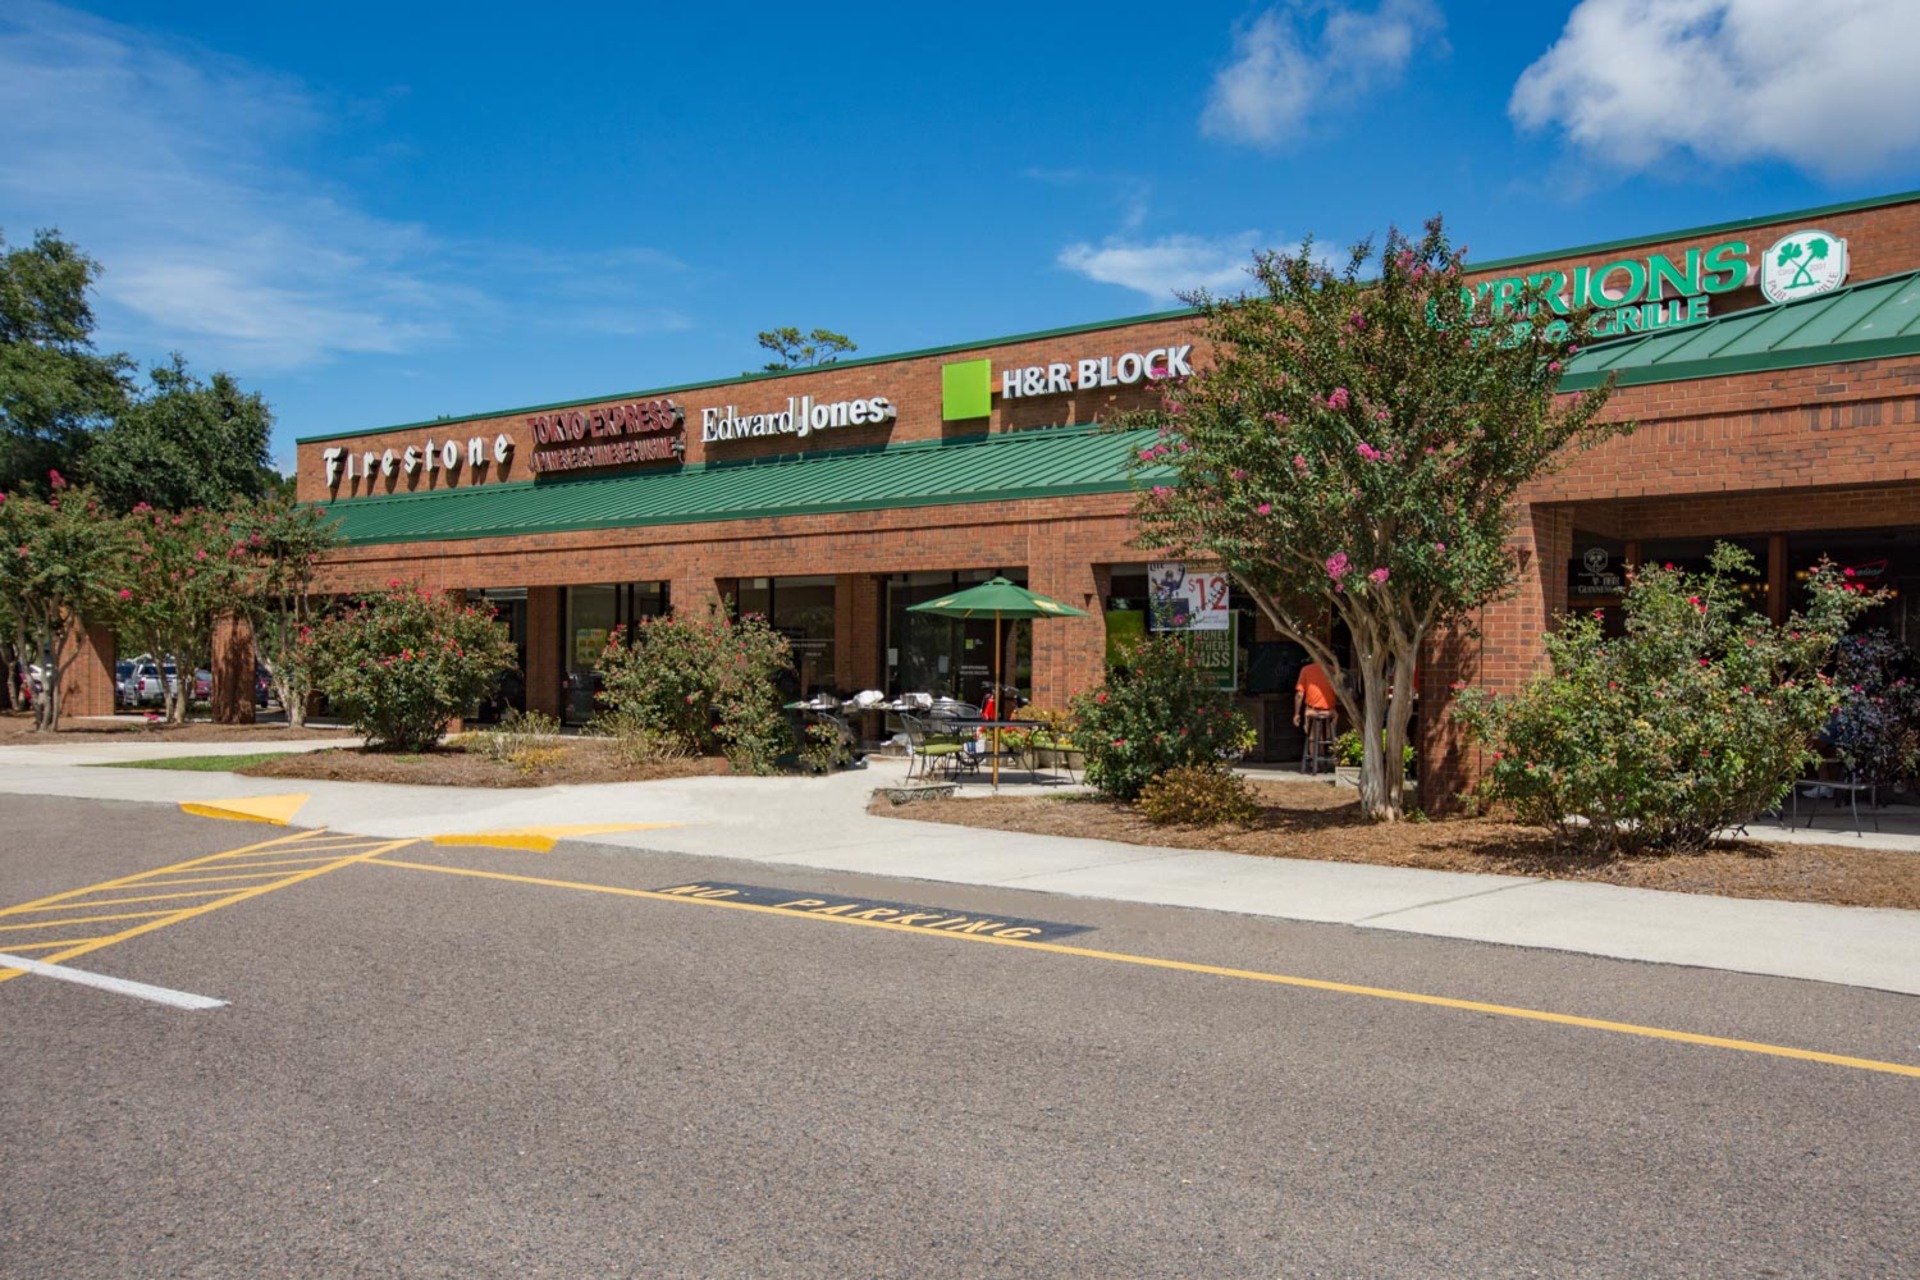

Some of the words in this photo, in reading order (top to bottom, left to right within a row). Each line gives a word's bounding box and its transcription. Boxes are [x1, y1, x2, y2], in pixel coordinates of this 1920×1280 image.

[1587, 295, 1709, 339] GRILLE
[1003, 360, 1073, 399] H&R
[1076, 344, 1196, 390] BLOCK
[526, 411, 586, 443] TOKYO
[590, 399, 675, 437] EXPRESS
[700, 396, 799, 443] Edward
[797, 393, 891, 438] Jones
[323, 432, 515, 488] Firestone
[1188, 576, 1227, 610] $12
[656, 884, 740, 899] NO
[773, 898, 1043, 940] PARKING
